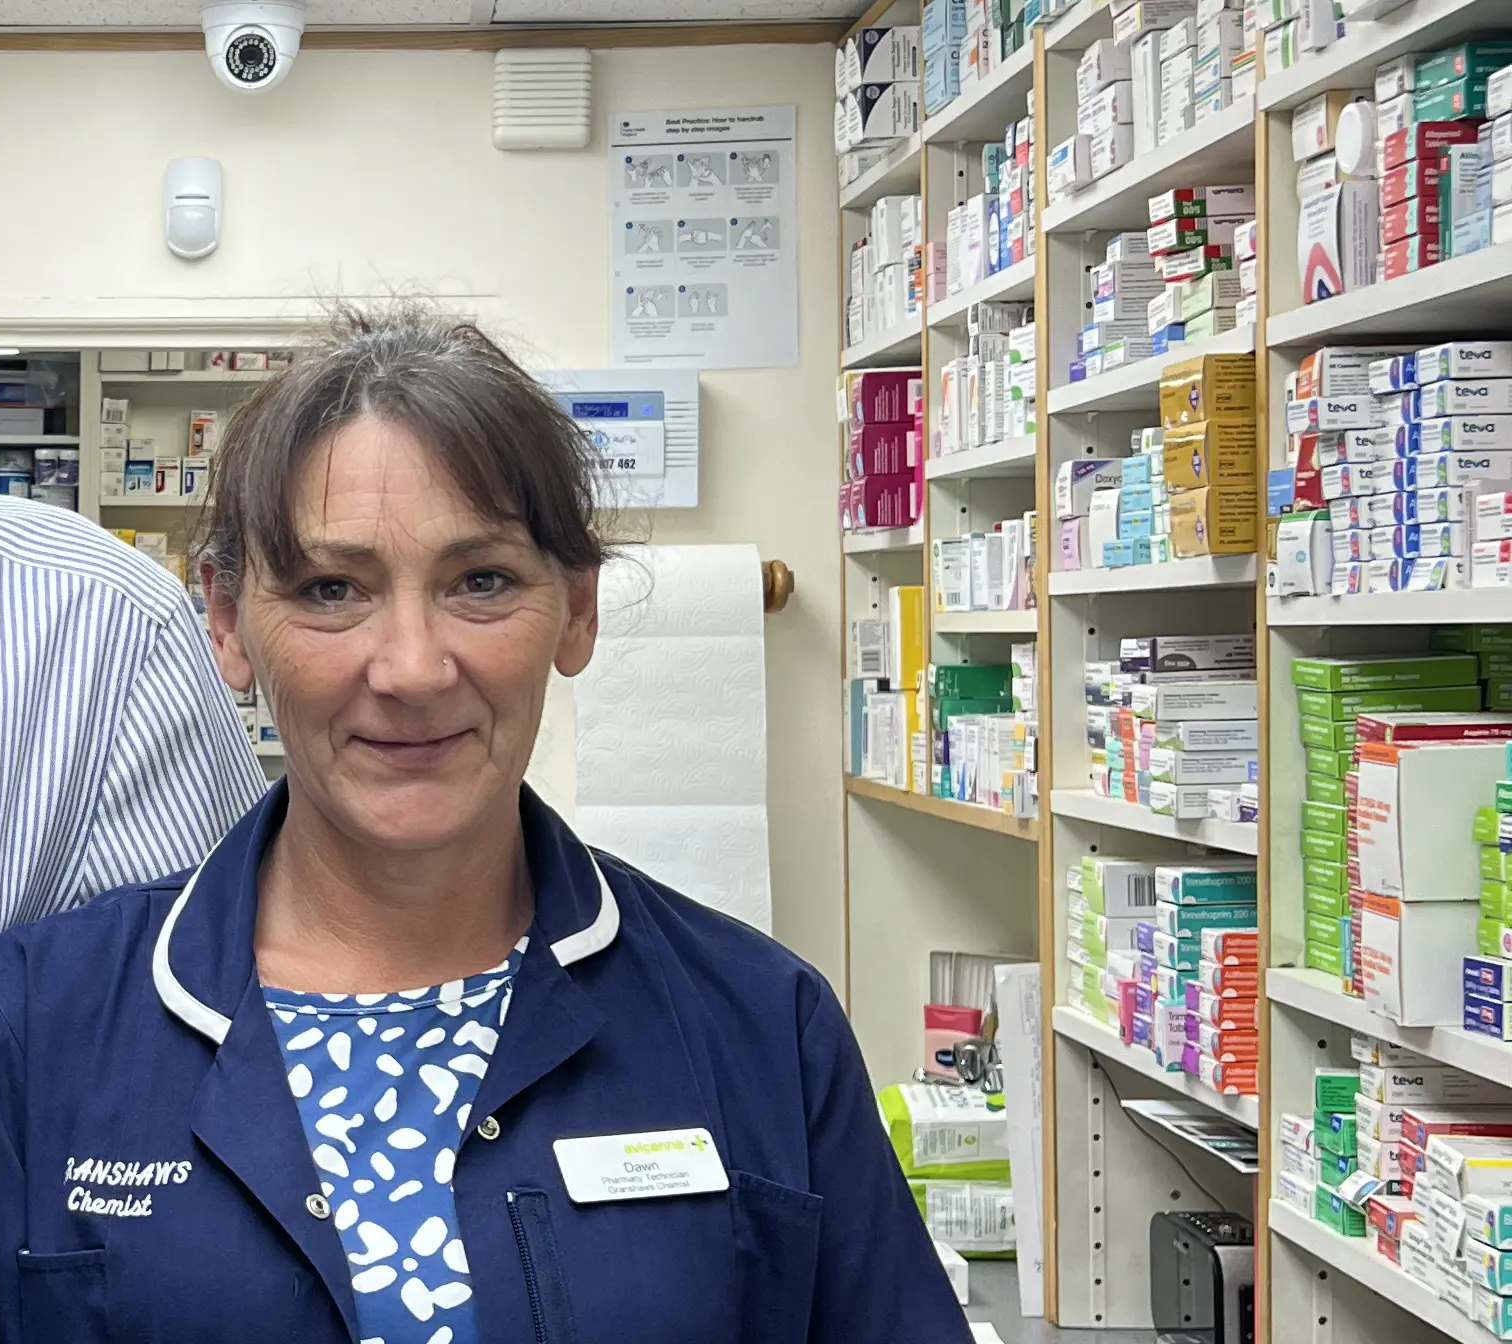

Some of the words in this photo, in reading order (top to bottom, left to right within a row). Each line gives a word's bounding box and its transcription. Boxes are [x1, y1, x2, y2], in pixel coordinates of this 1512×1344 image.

[1459, 349, 1492, 361] teva
[1455, 386, 1489, 398] teva
[1327, 402, 1357, 413] teva
[1462, 421, 1495, 433] teva
[617, 458, 636, 469] 462
[1457, 458, 1490, 469] teva
[1392, 1075, 1424, 1087] teva
[623, 1139, 685, 1155] avicenna
[624, 1161, 660, 1173] Dawn
[601, 1175, 643, 1185] Pharmacy
[646, 1170, 690, 1181] Technician
[607, 1184, 656, 1195] Granshaws
[658, 1180, 691, 1191] Chemist
[67, 1186, 153, 1217] Chemist
